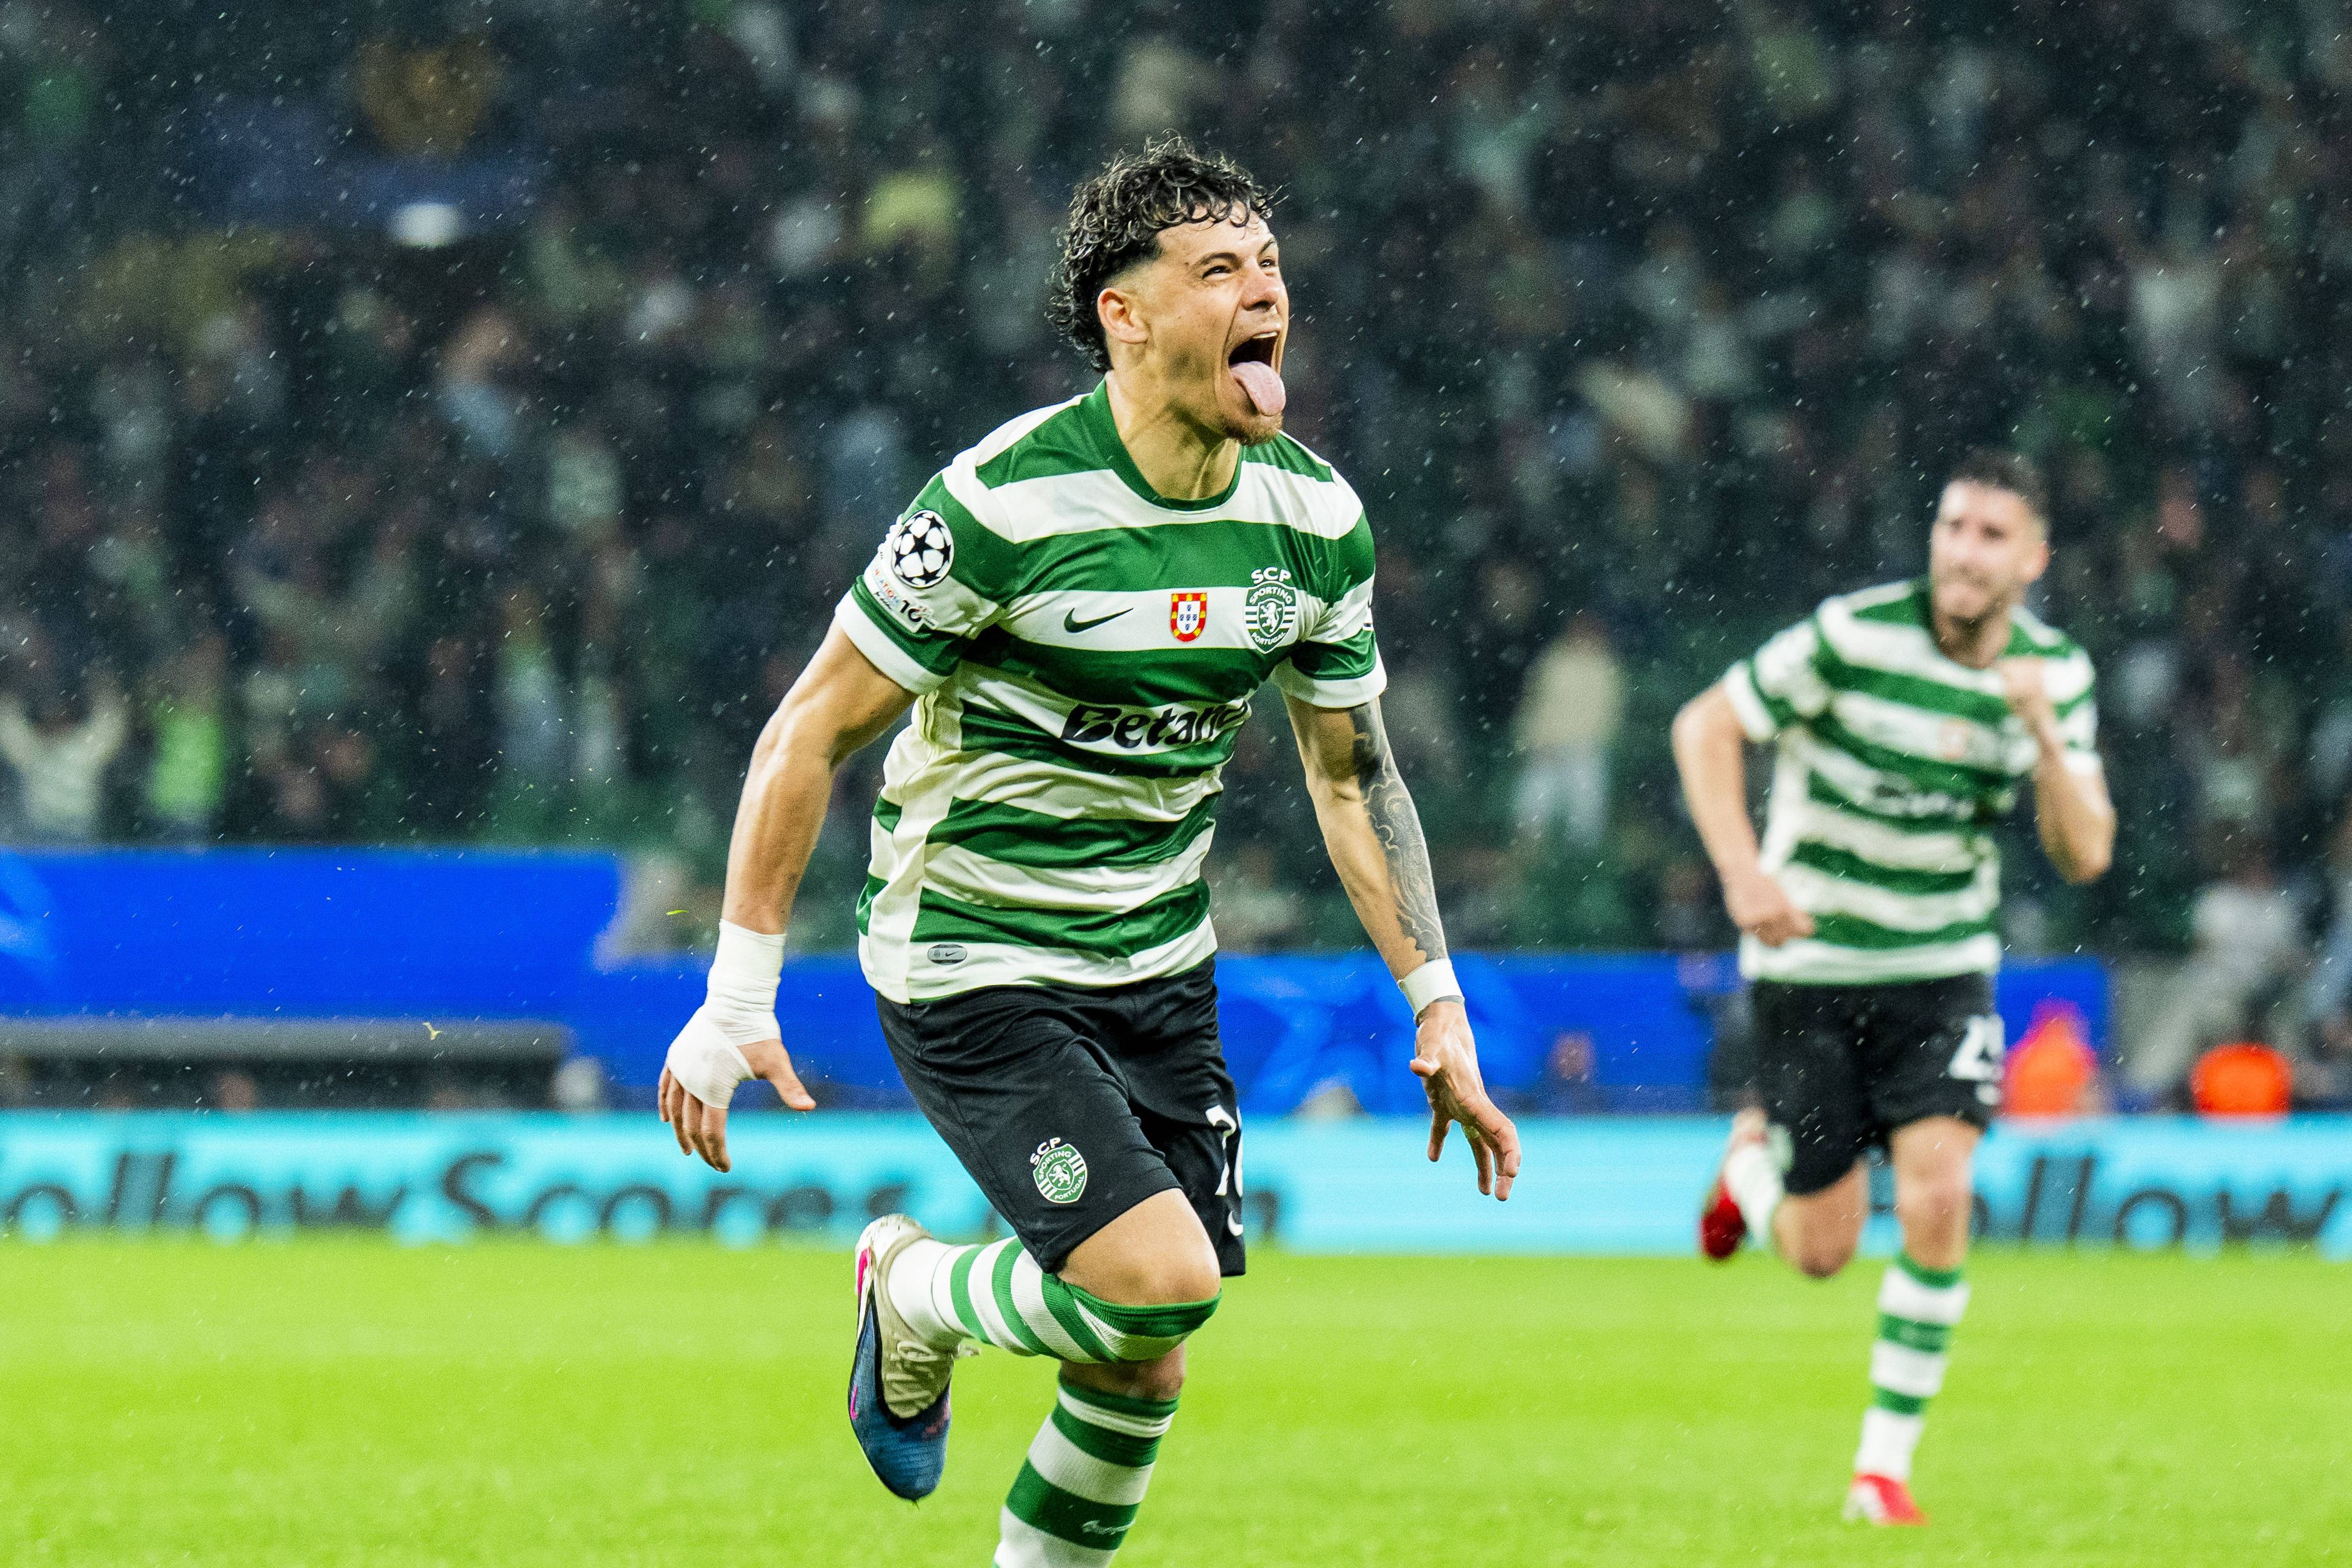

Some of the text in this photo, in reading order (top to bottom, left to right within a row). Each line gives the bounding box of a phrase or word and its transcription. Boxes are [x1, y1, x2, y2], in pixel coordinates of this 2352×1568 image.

[1251, 567, 1291, 584] SCP
[1249, 586, 1293, 605] SPORTING
[1251, 632, 1286, 645] PORTUGAL
[1030, 1137, 1061, 1166] SCP
[1038, 1151, 1073, 1180] SPORTING
[1053, 1174, 1084, 1200] PORTUGAL
